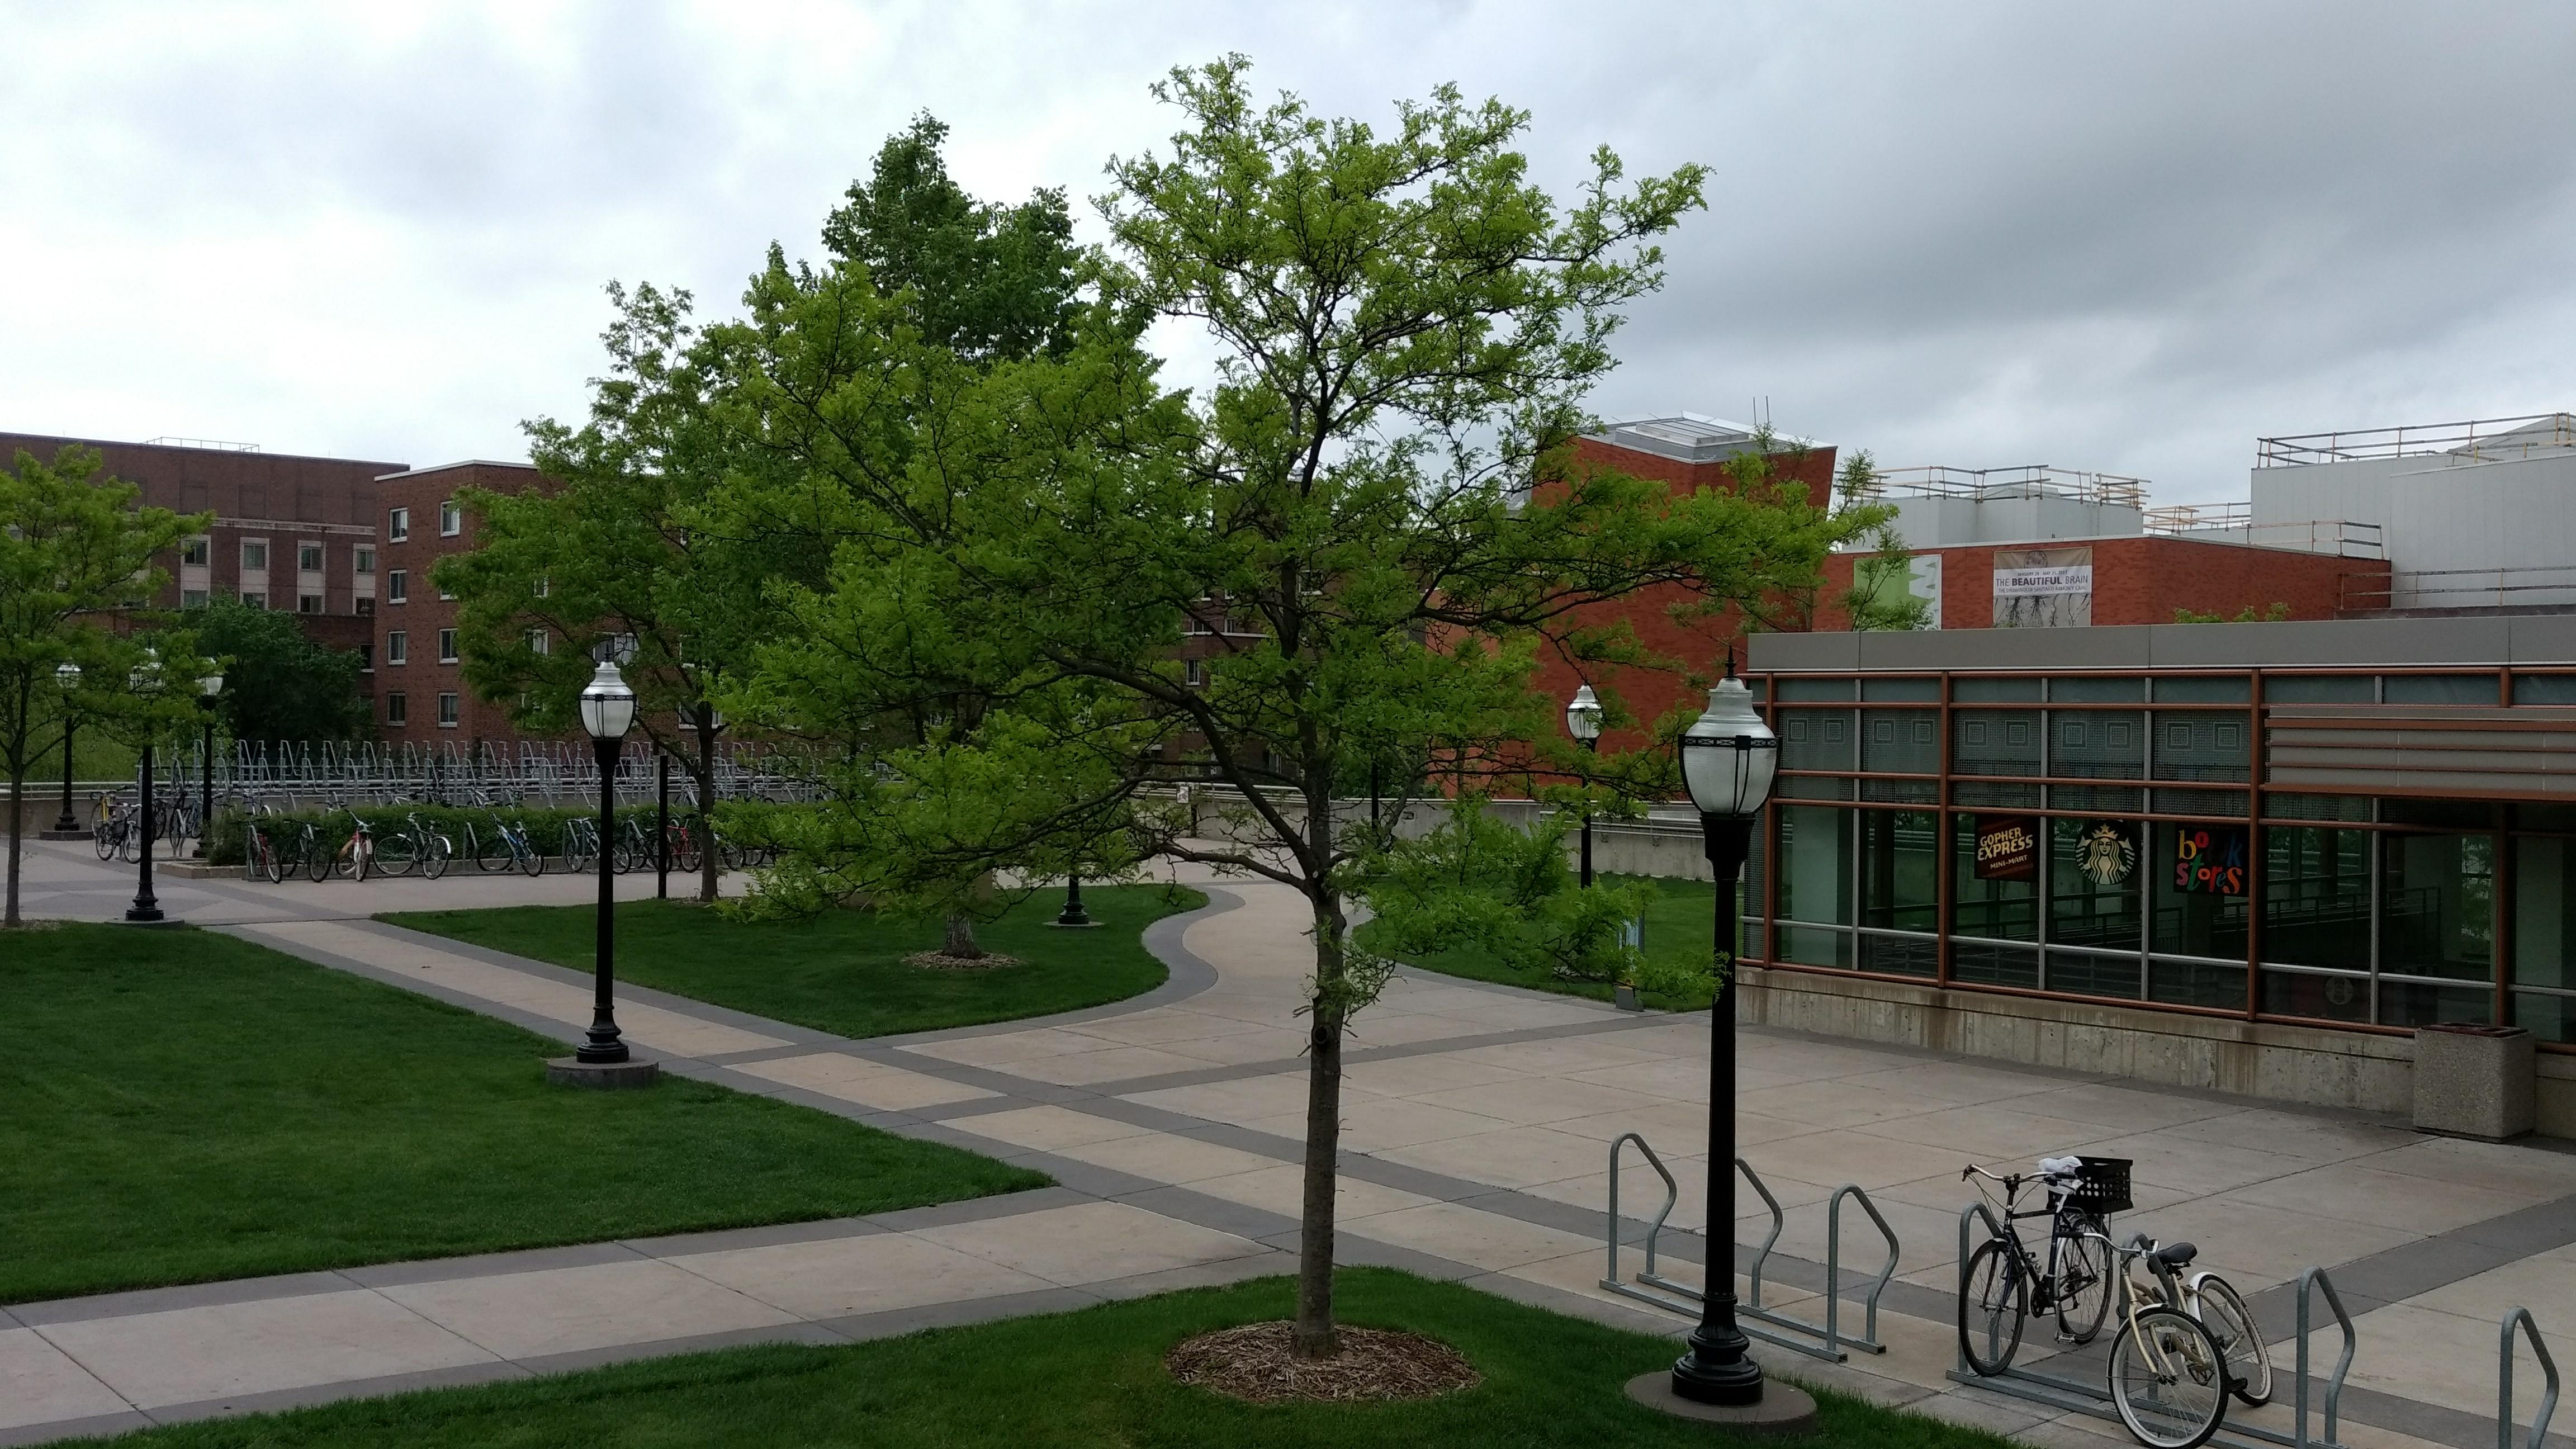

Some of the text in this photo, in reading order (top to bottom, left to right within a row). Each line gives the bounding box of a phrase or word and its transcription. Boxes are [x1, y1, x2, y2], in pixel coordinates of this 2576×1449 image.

[1996, 575, 2088, 586] THE BEAUTIFUL BRAIN
[1980, 827, 2022, 847] GOPHER
[1977, 834, 2033, 861] EXPRESS
[1990, 855, 2028, 869] MINI-MART
[2176, 853, 2242, 894] stores
